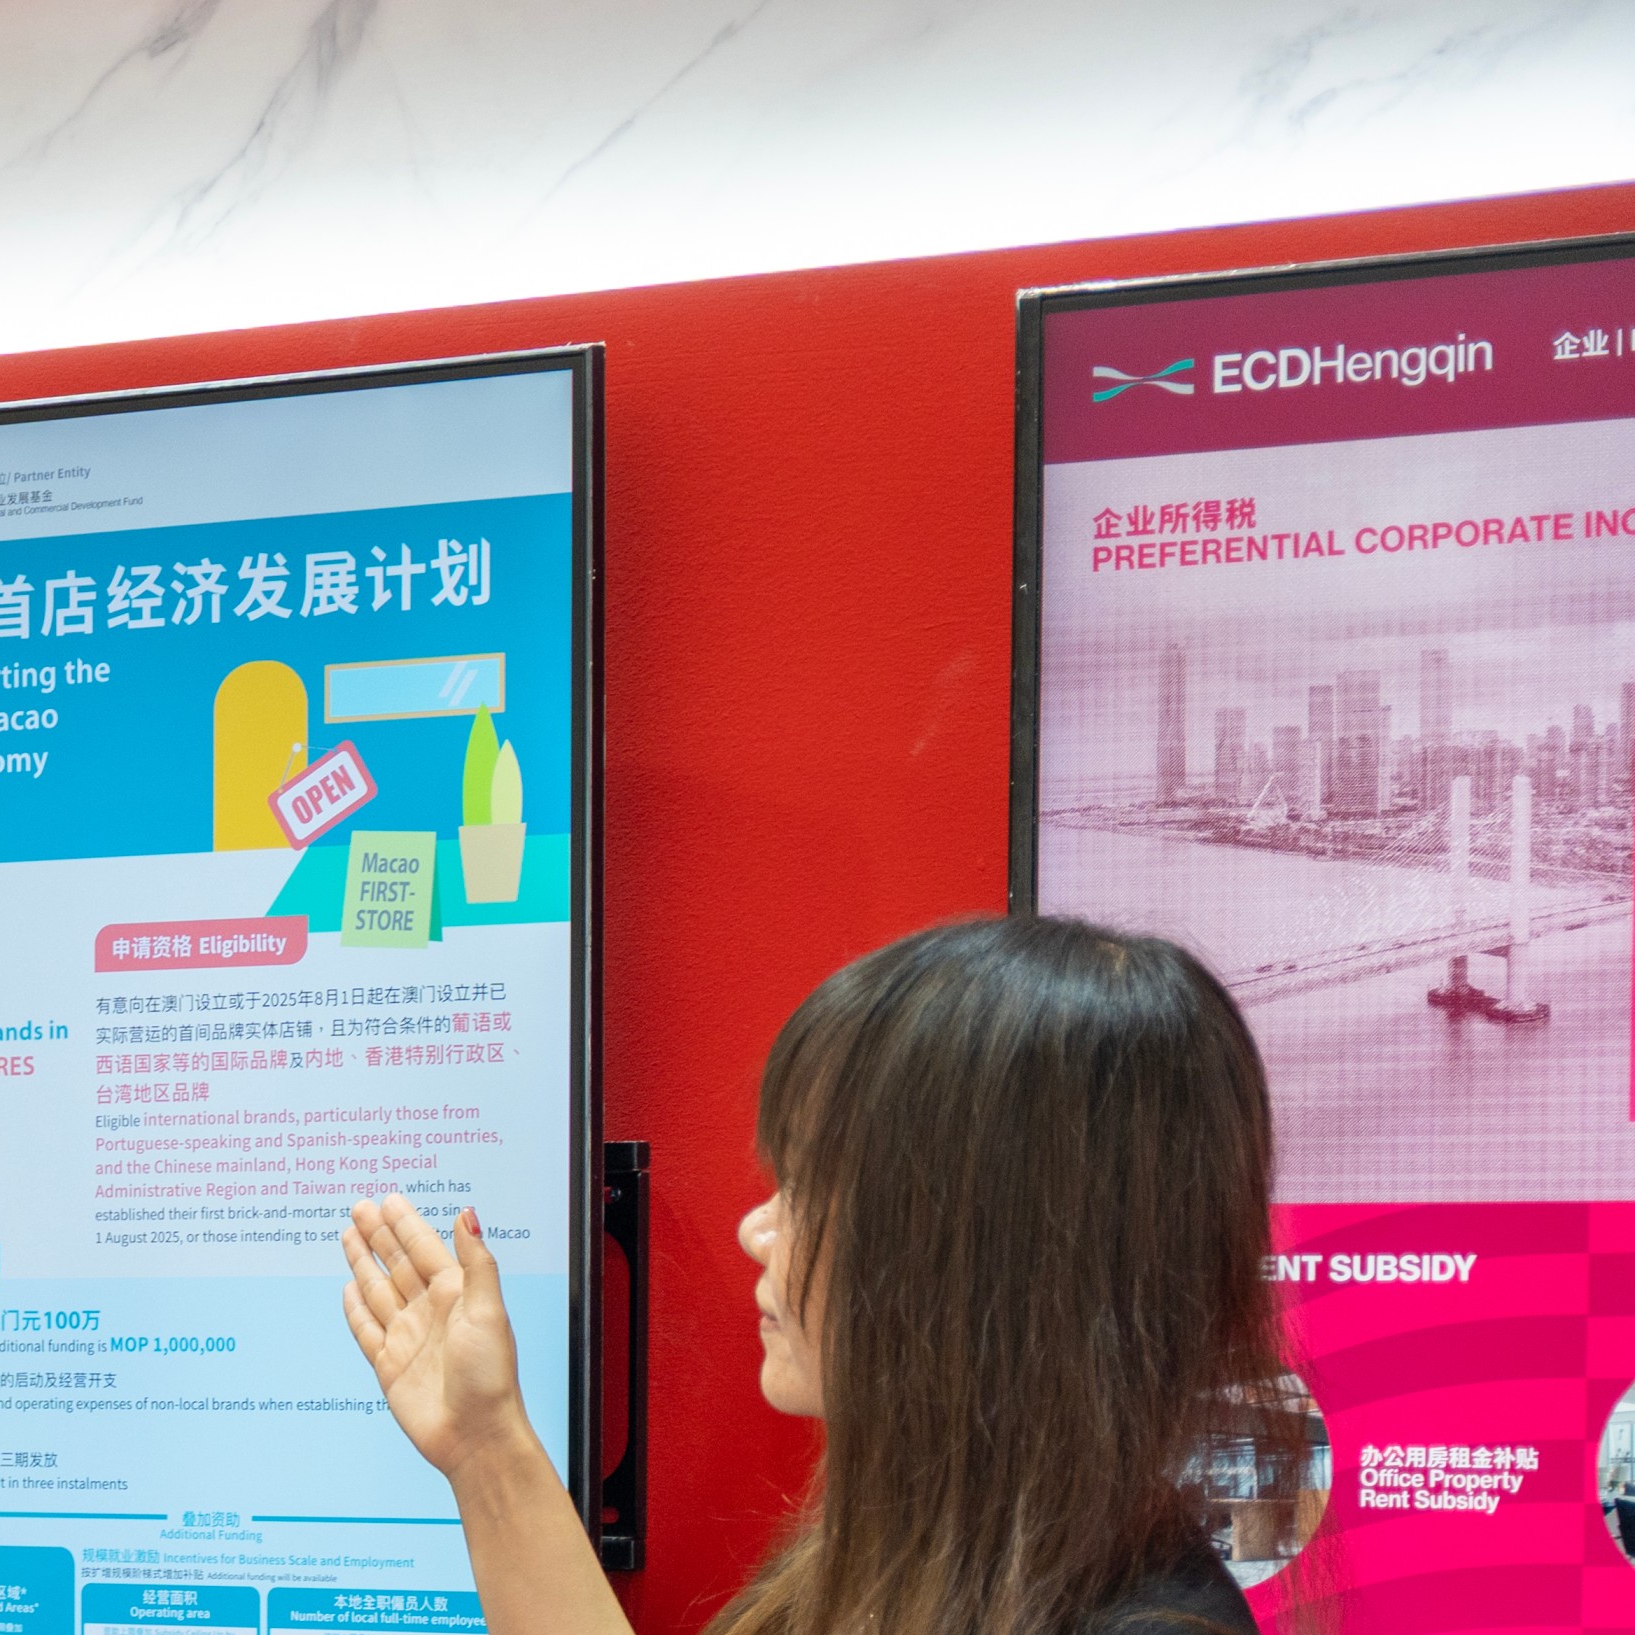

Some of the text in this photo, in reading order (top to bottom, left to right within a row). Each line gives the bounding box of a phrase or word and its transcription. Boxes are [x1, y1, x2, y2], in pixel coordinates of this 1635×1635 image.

[1213, 333, 1493, 393] ECDHengqin
[14, 471, 55, 482] Partner
[57, 466, 91, 479] Entity
[1093, 497, 1256, 540] 企业所得税
[1092, 530, 1345, 573] PREFERENTIAL
[1354, 513, 1573, 554] CORPORATE
[64, 658, 110, 685] the
[291, 761, 358, 826] OPEN
[362, 852, 420, 874] Macao
[360, 880, 415, 902] FIRST-
[355, 909, 414, 931] STORE
[112, 933, 287, 960] 申请资格 Eligibility
[95, 1104, 480, 1132] Eligible international brands, particularly those from
[1329, 1254, 1476, 1282] SUBSIDY
[1361, 1446, 1538, 1473] 办公用房租金补贴
[1360, 1467, 1523, 1493] Office Property
[1360, 1487, 1500, 1514] Rent Subsidy
